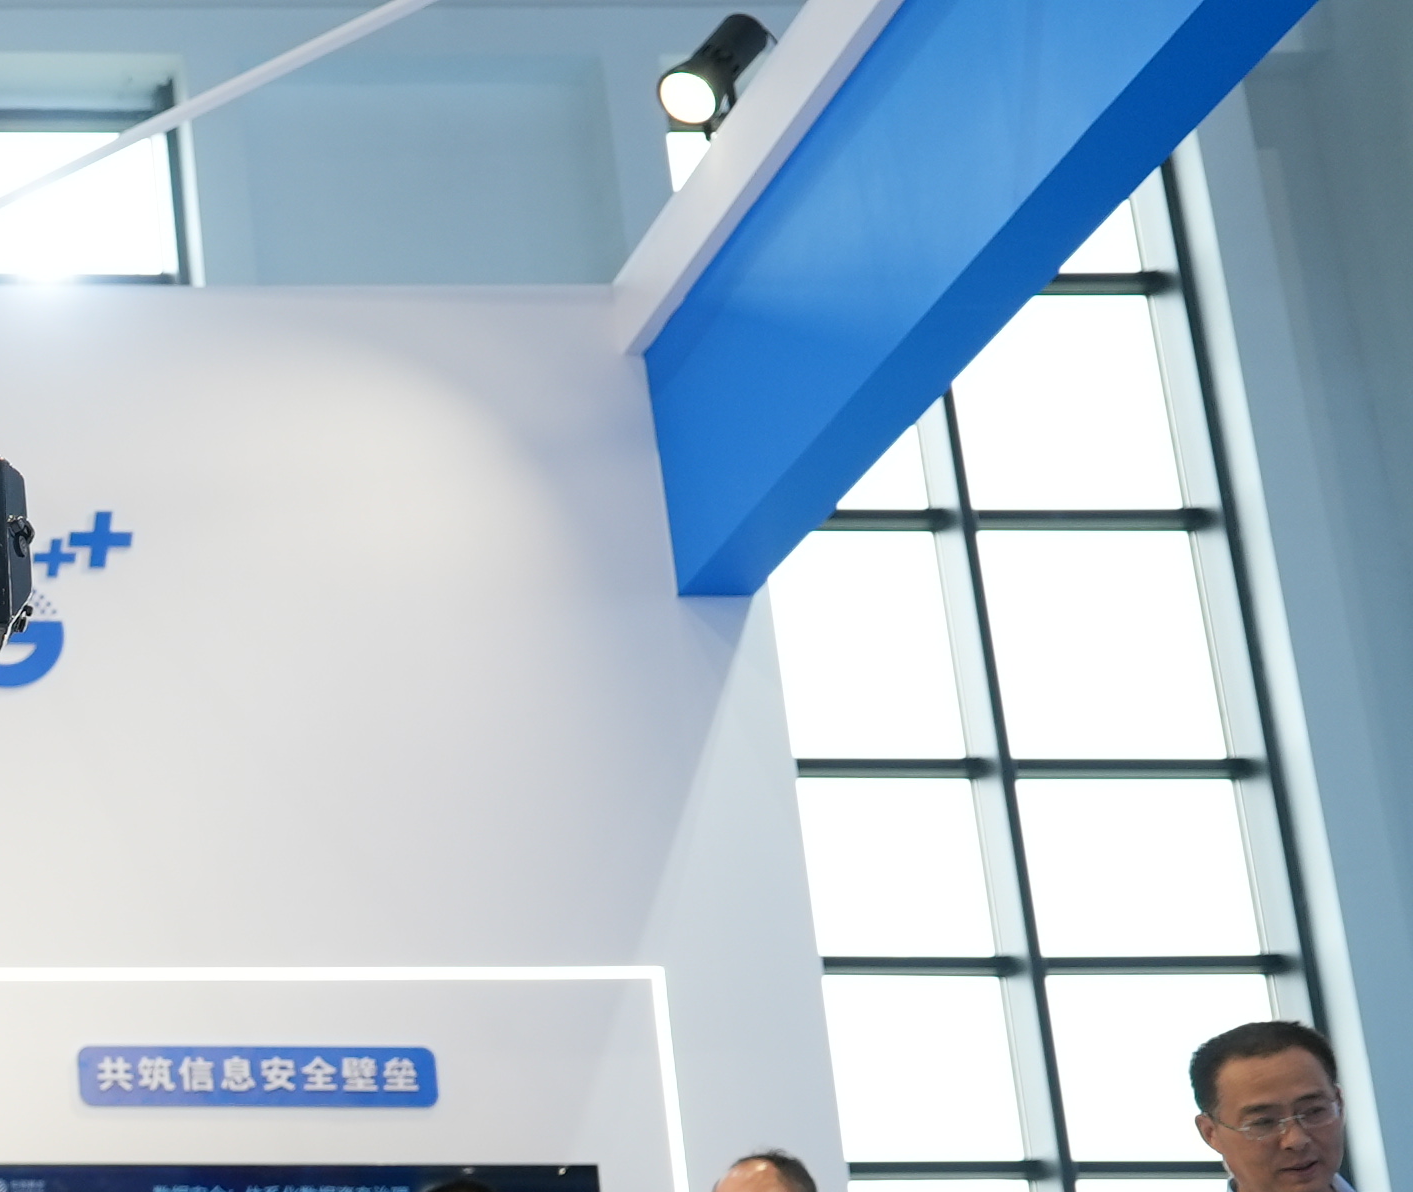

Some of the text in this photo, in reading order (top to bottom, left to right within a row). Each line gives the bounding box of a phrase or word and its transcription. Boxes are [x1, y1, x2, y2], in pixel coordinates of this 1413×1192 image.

[97, 1055, 420, 1093] 共筑信息安全壁垒
